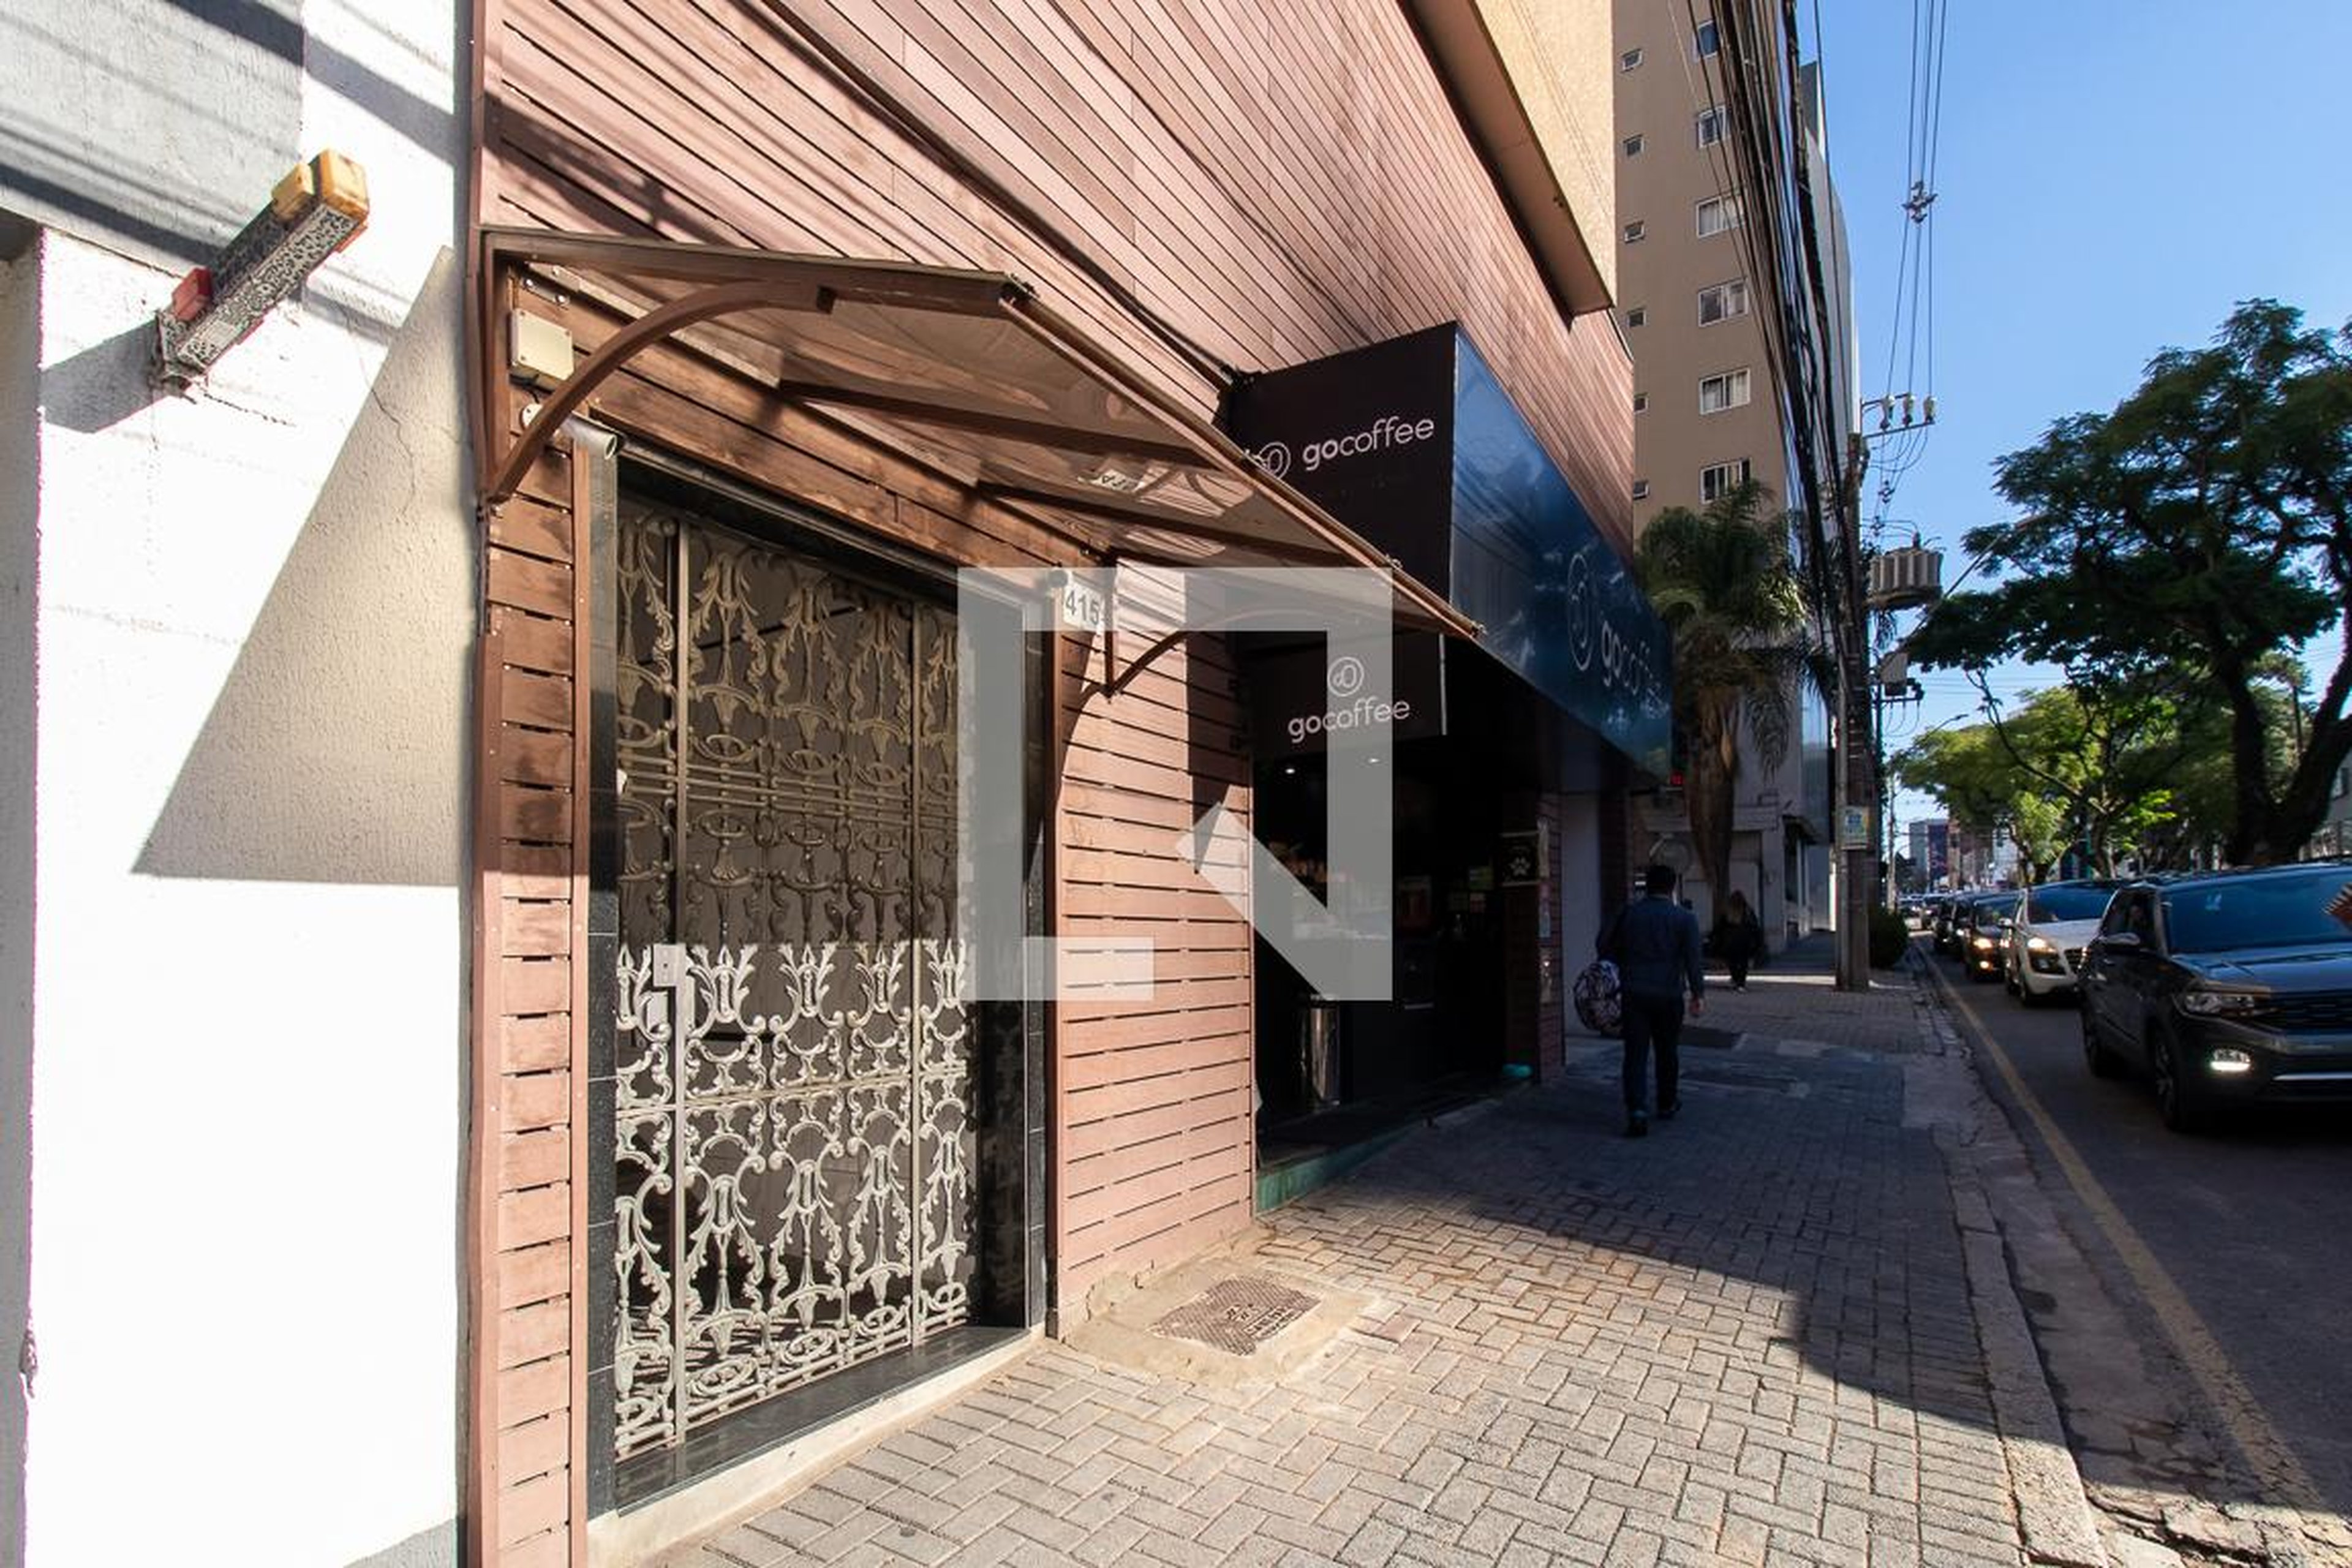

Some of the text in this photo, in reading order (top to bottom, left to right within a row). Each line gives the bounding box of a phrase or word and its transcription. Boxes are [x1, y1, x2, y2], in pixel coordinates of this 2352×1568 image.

[1302, 415, 1434, 472] gocoffee
[1066, 590, 1099, 625] 415
[1288, 696, 1410, 743] gocoffee
